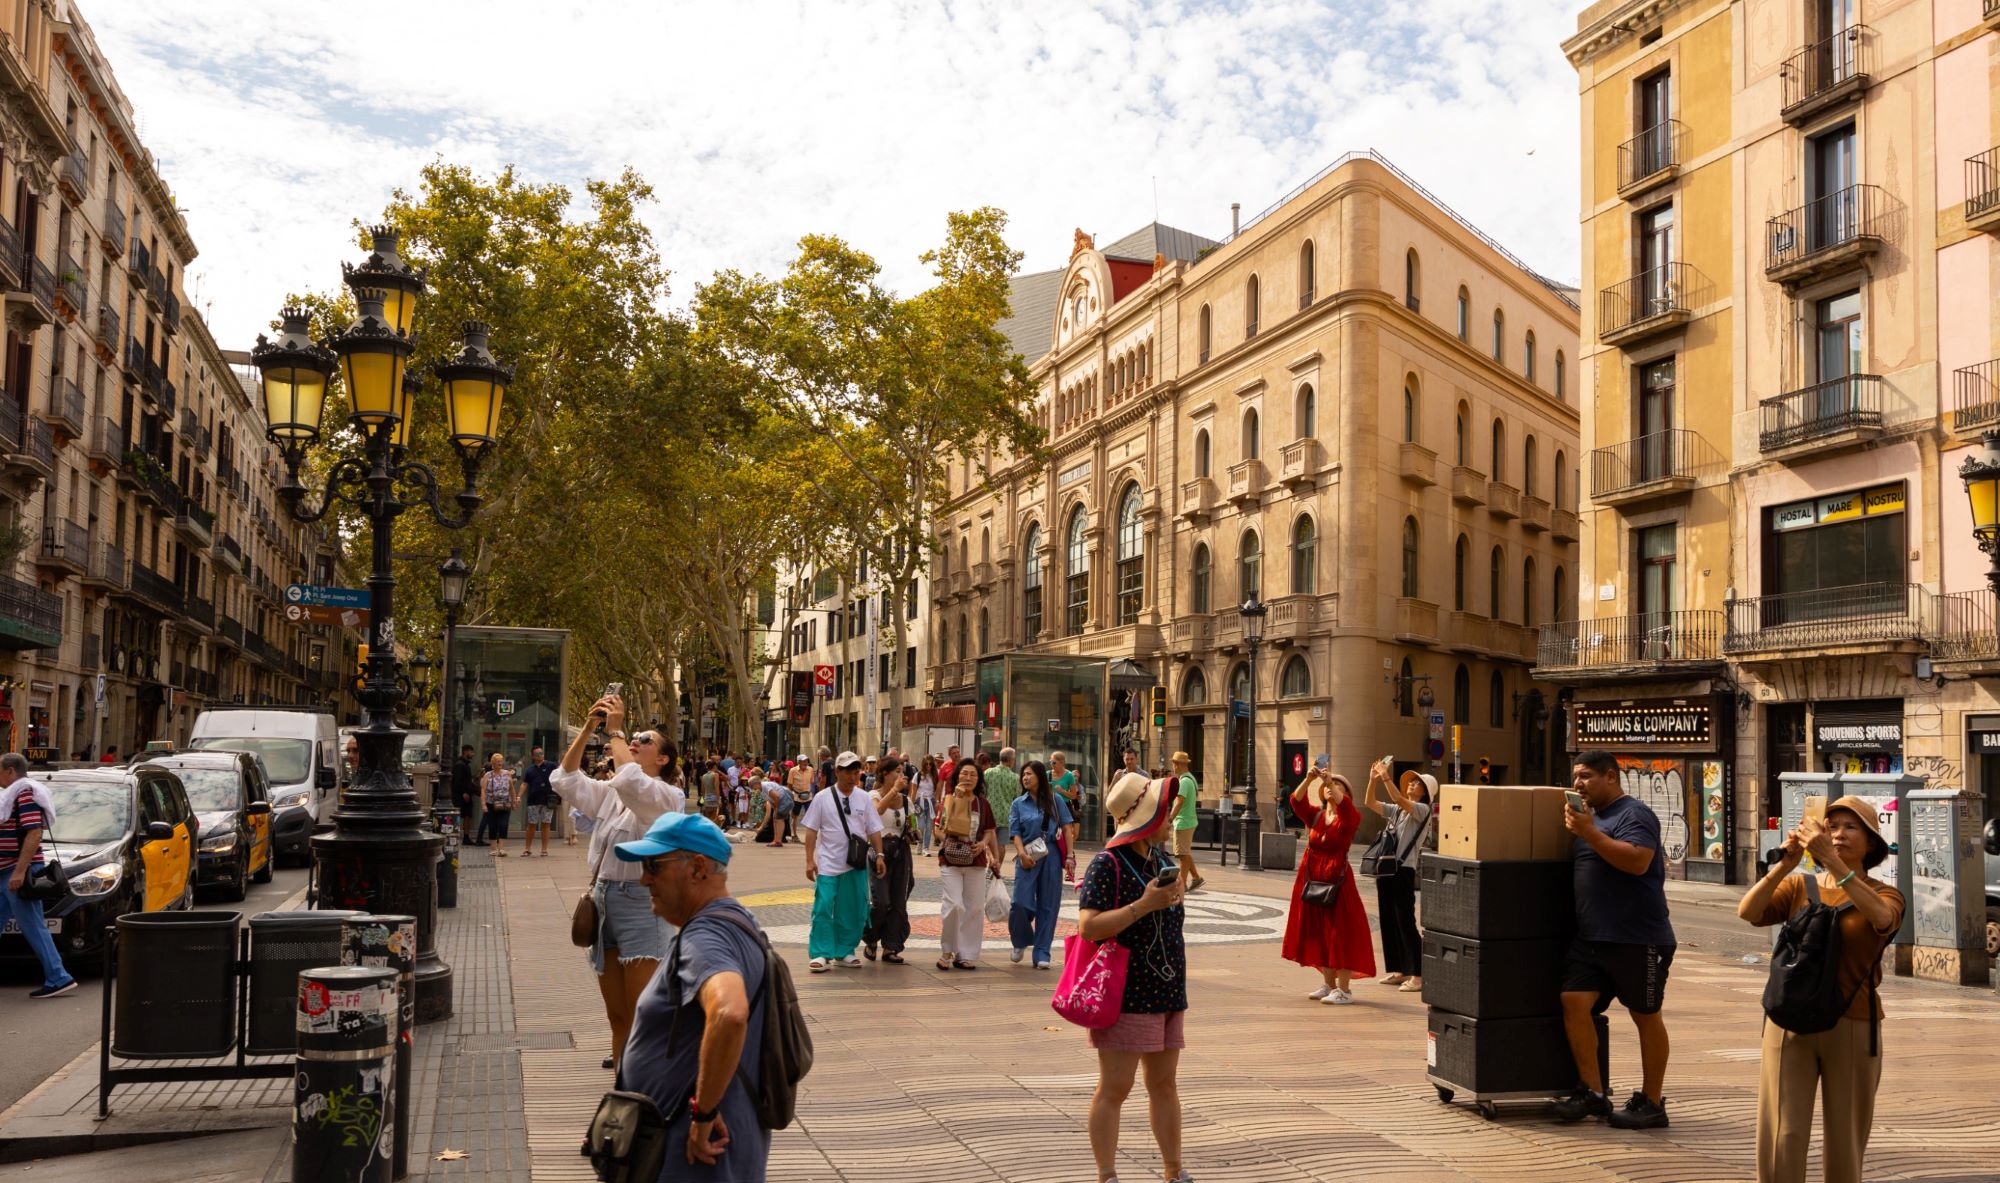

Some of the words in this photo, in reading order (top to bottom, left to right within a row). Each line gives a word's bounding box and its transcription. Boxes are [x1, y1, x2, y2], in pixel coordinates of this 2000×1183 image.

[1780, 507, 1812, 522] HOSTAL
[1827, 500, 1852, 514] MARE
[1586, 716, 1632, 733] HUMMUS
[1633, 716, 1642, 732] &
[1643, 715, 1699, 733] COMPANY
[1625, 734, 1646, 742] lebanese
[1646, 734, 1657, 743] grill
[1819, 726, 1865, 741] SOUVENIRS
[1865, 725, 1901, 740] SPORTS
[28, 749, 47, 759] TAXI
